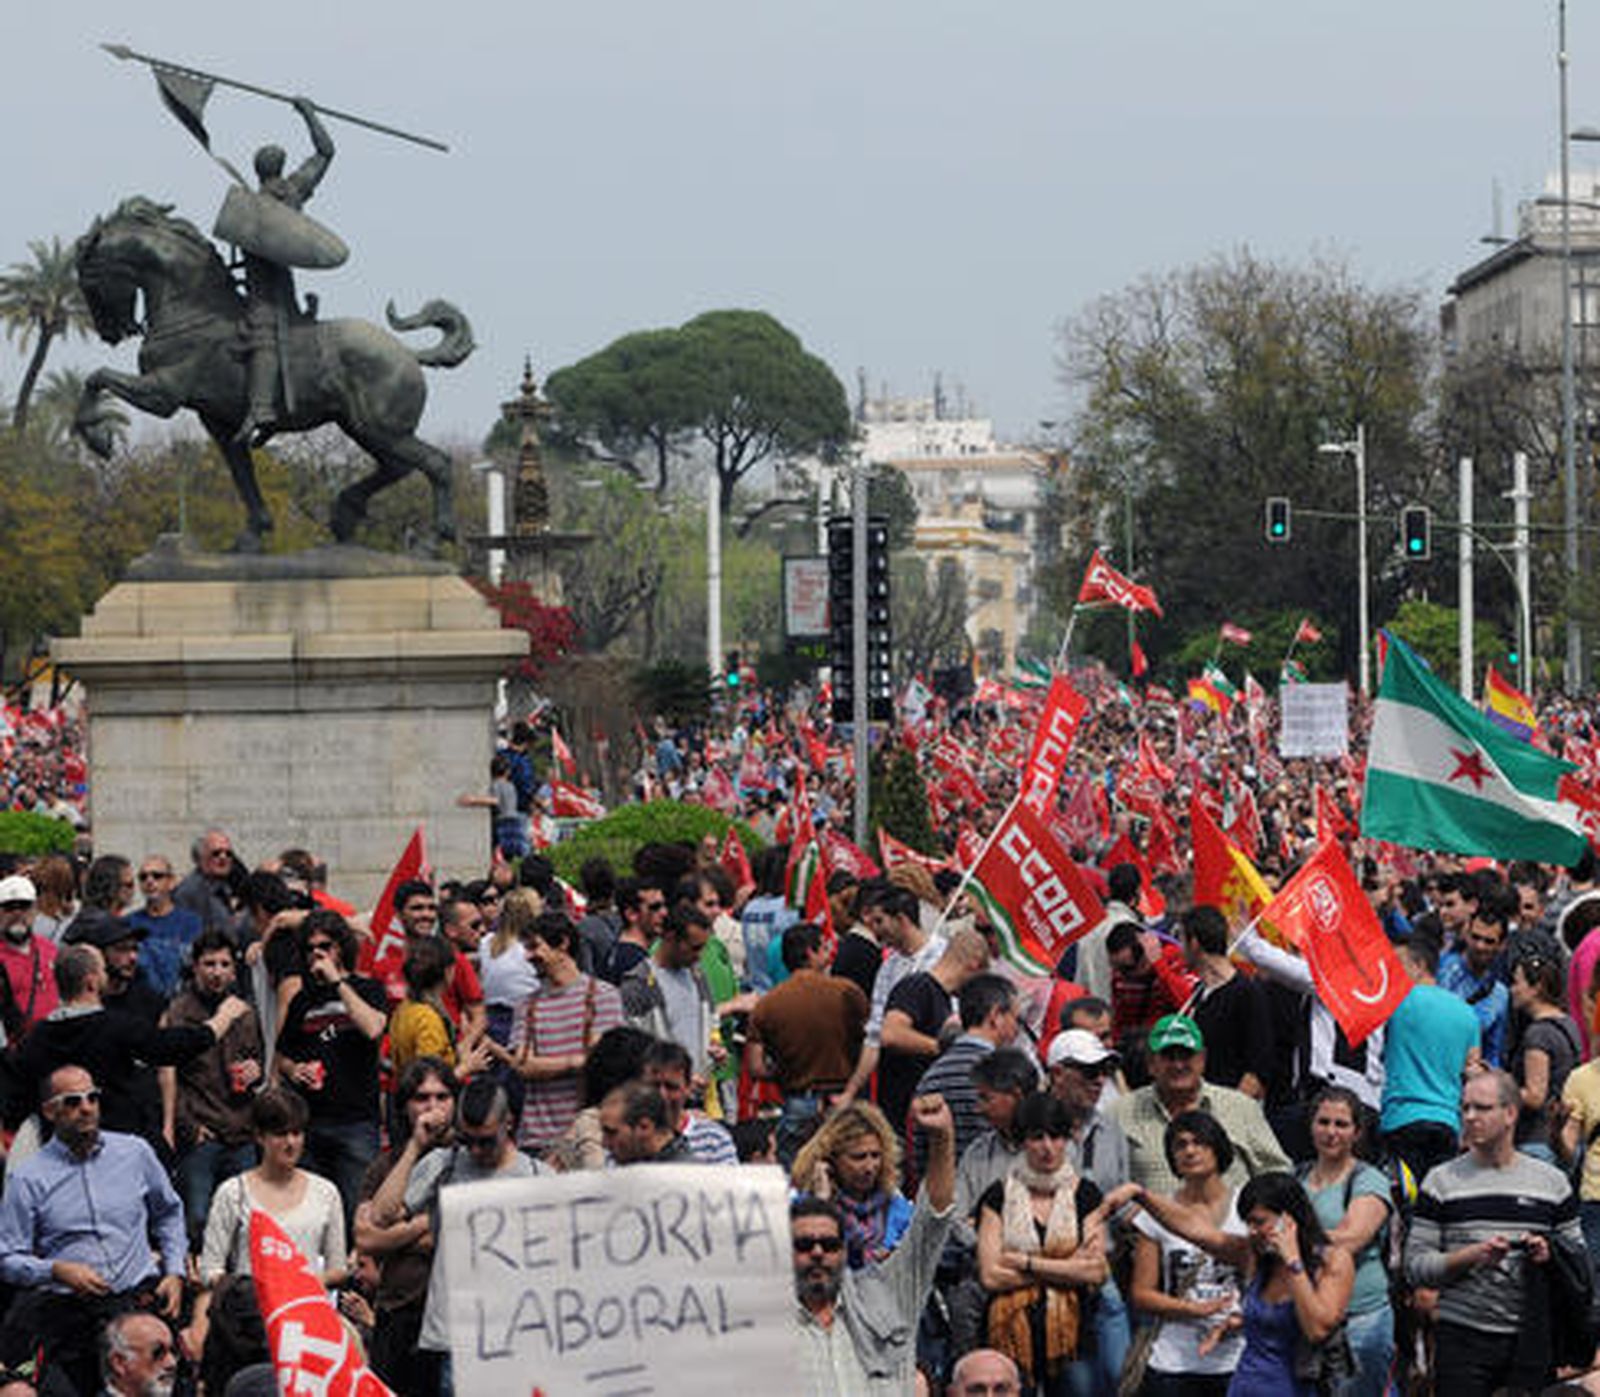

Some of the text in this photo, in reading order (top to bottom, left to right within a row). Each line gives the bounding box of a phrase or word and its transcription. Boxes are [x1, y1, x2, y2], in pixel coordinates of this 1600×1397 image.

[999, 823, 1086, 936] CCOO
[466, 1190, 779, 1271] REFORMA
[474, 1284, 755, 1360] LABORAL
